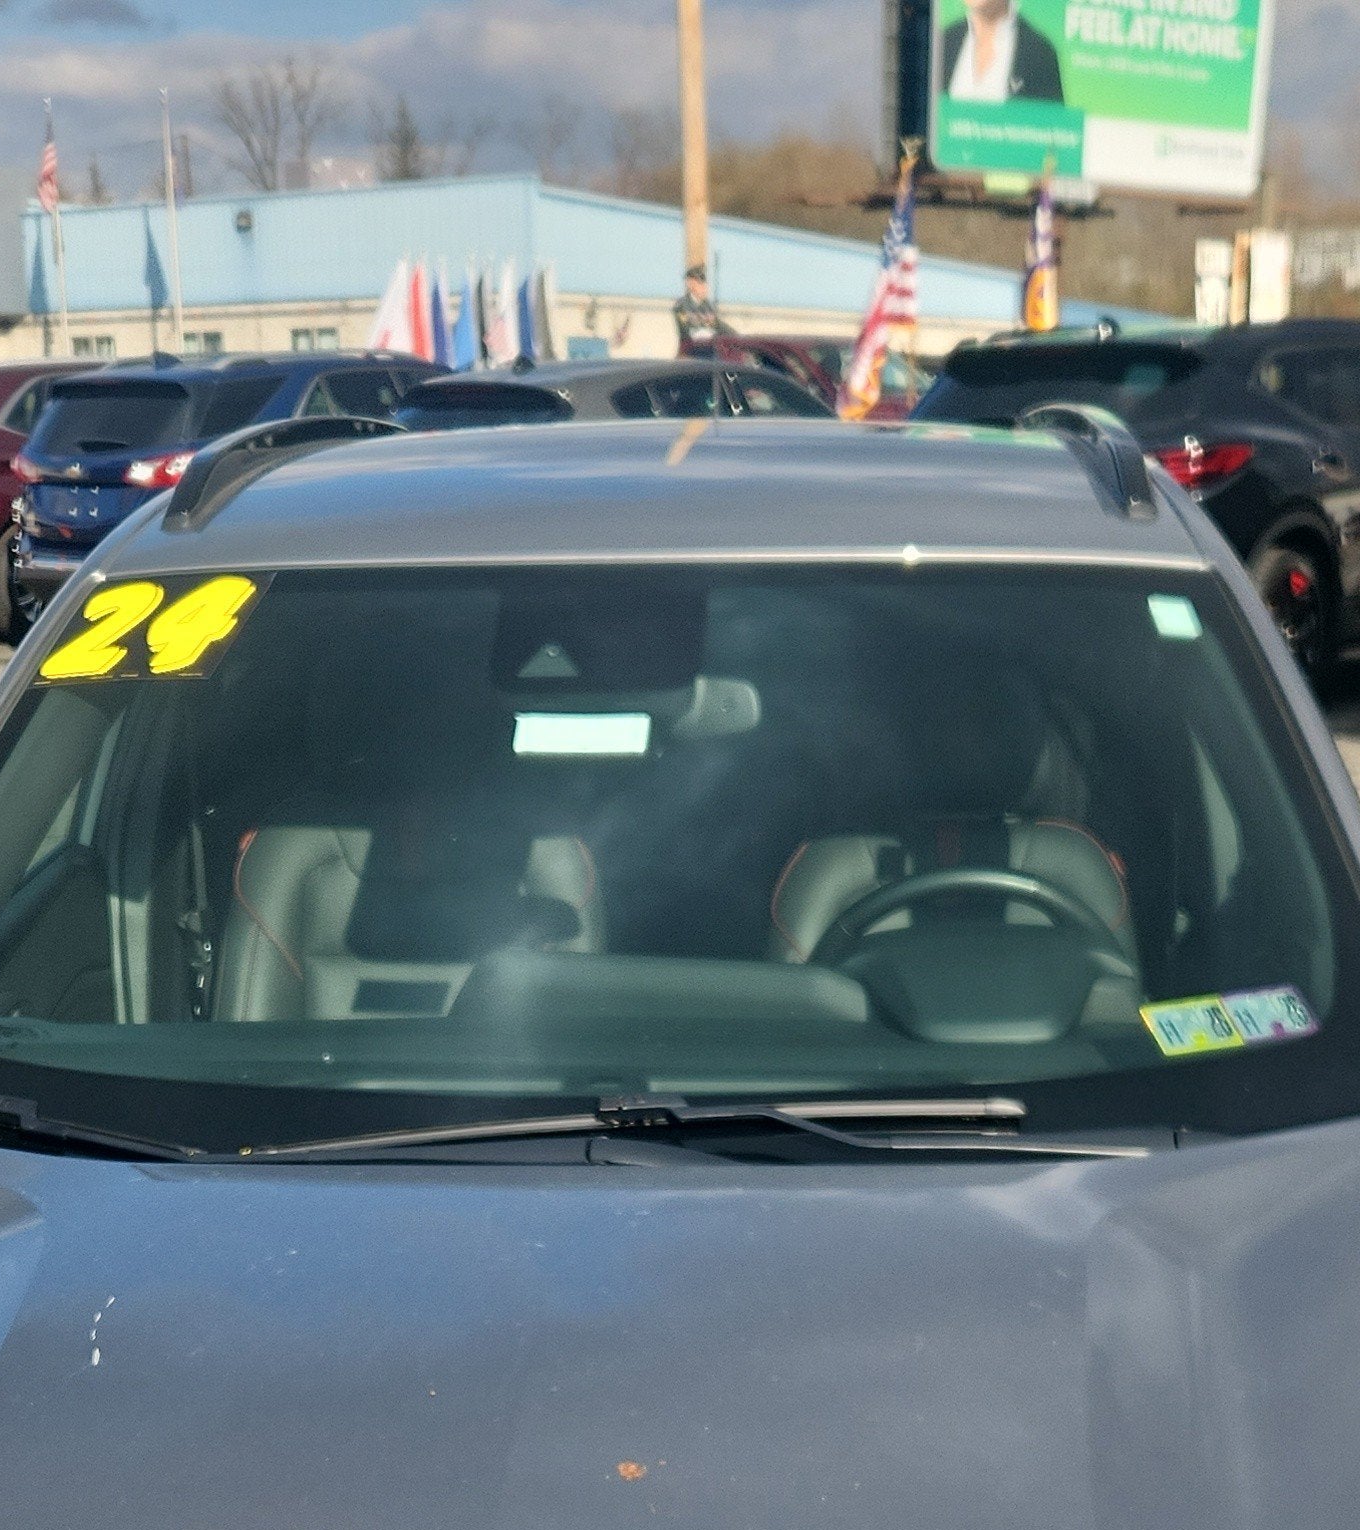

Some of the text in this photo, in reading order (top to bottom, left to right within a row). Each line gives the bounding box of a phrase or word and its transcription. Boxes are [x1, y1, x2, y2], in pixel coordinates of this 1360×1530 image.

[1065, 5, 1123, 46] FEEL
[1123, 13, 1164, 49] AT
[40, 576, 257, 680] 24
